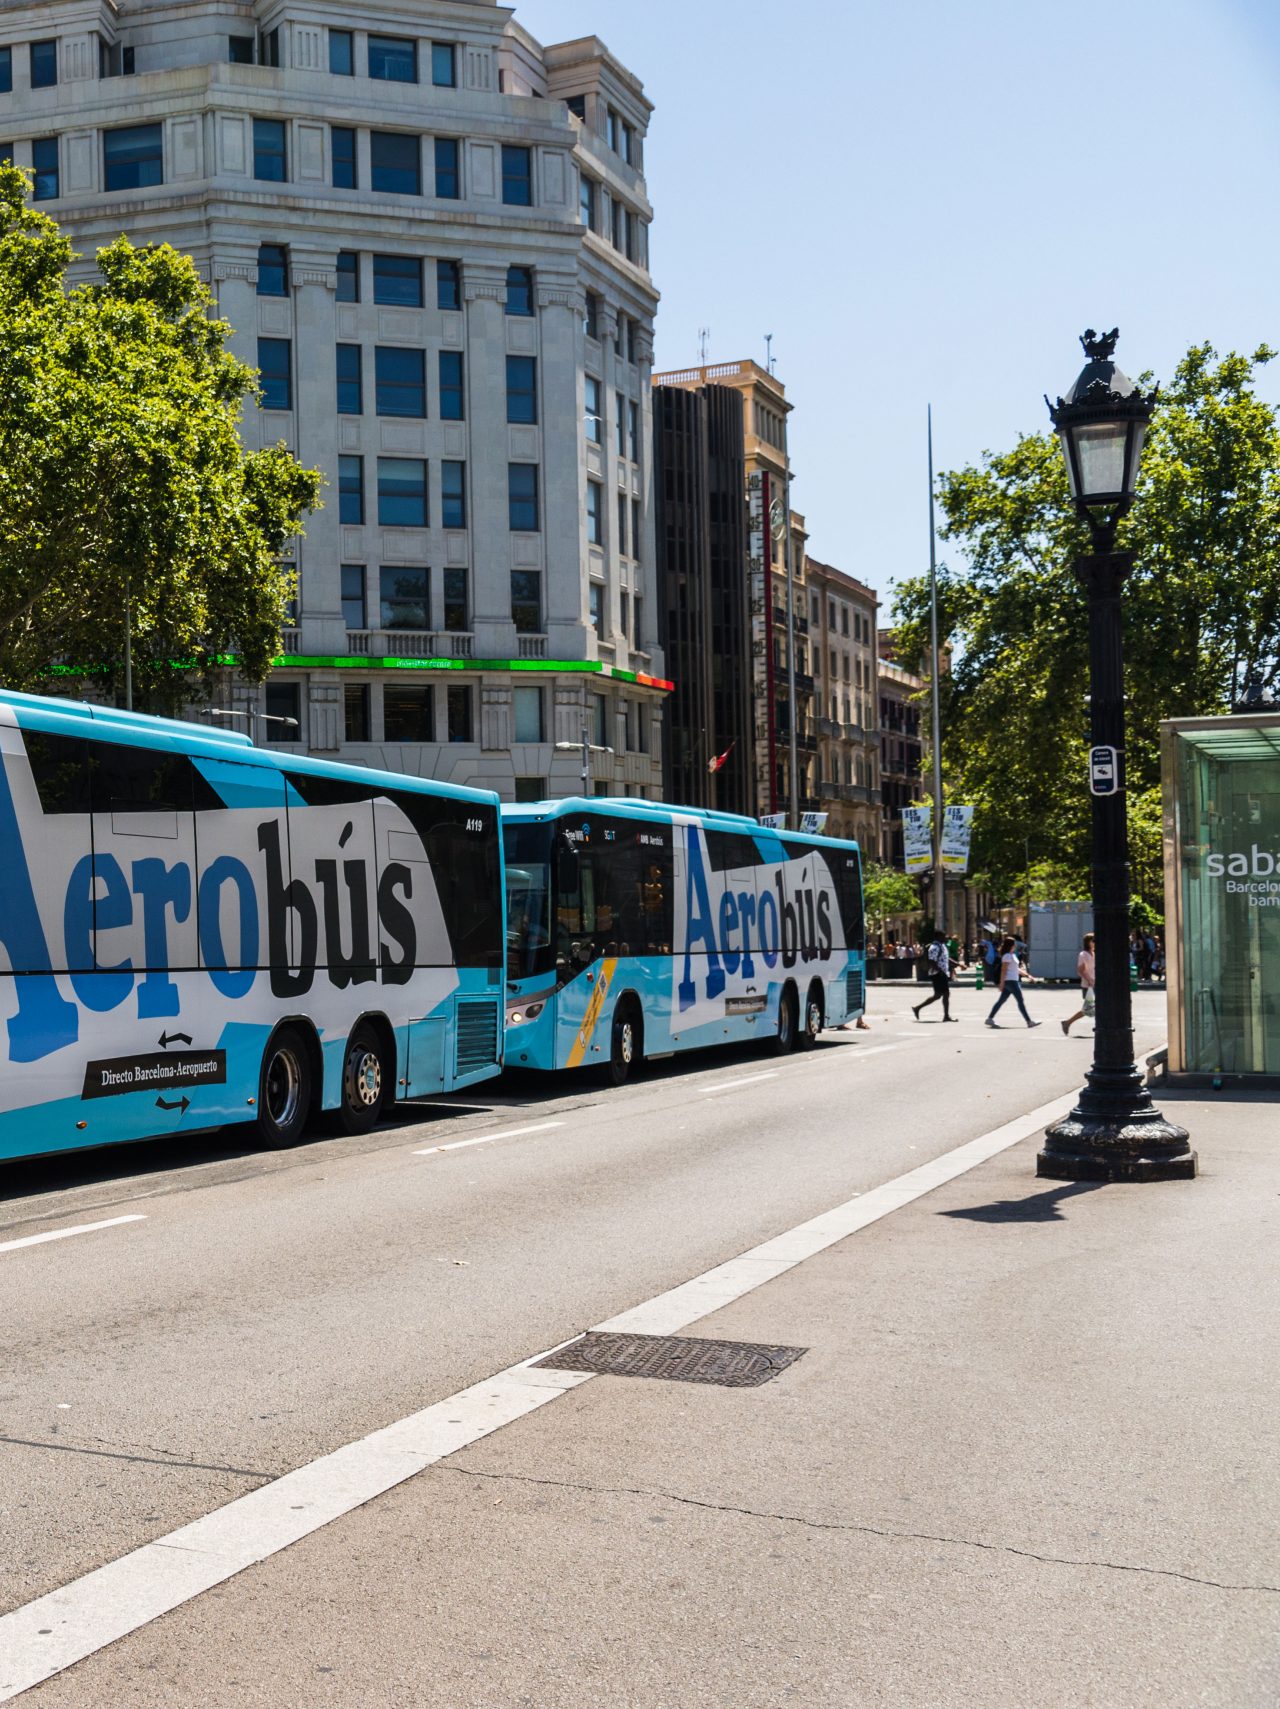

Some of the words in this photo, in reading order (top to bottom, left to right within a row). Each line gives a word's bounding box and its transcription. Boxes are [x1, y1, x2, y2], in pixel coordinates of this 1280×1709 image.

[465, 818, 483, 832] A119
[1206, 843, 1280, 877] sab
[679, 824, 832, 1013] Aerobús
[101, 1069, 133, 1086] Directo
[134, 1060, 218, 1081] Barcelona-Aeropuerto
